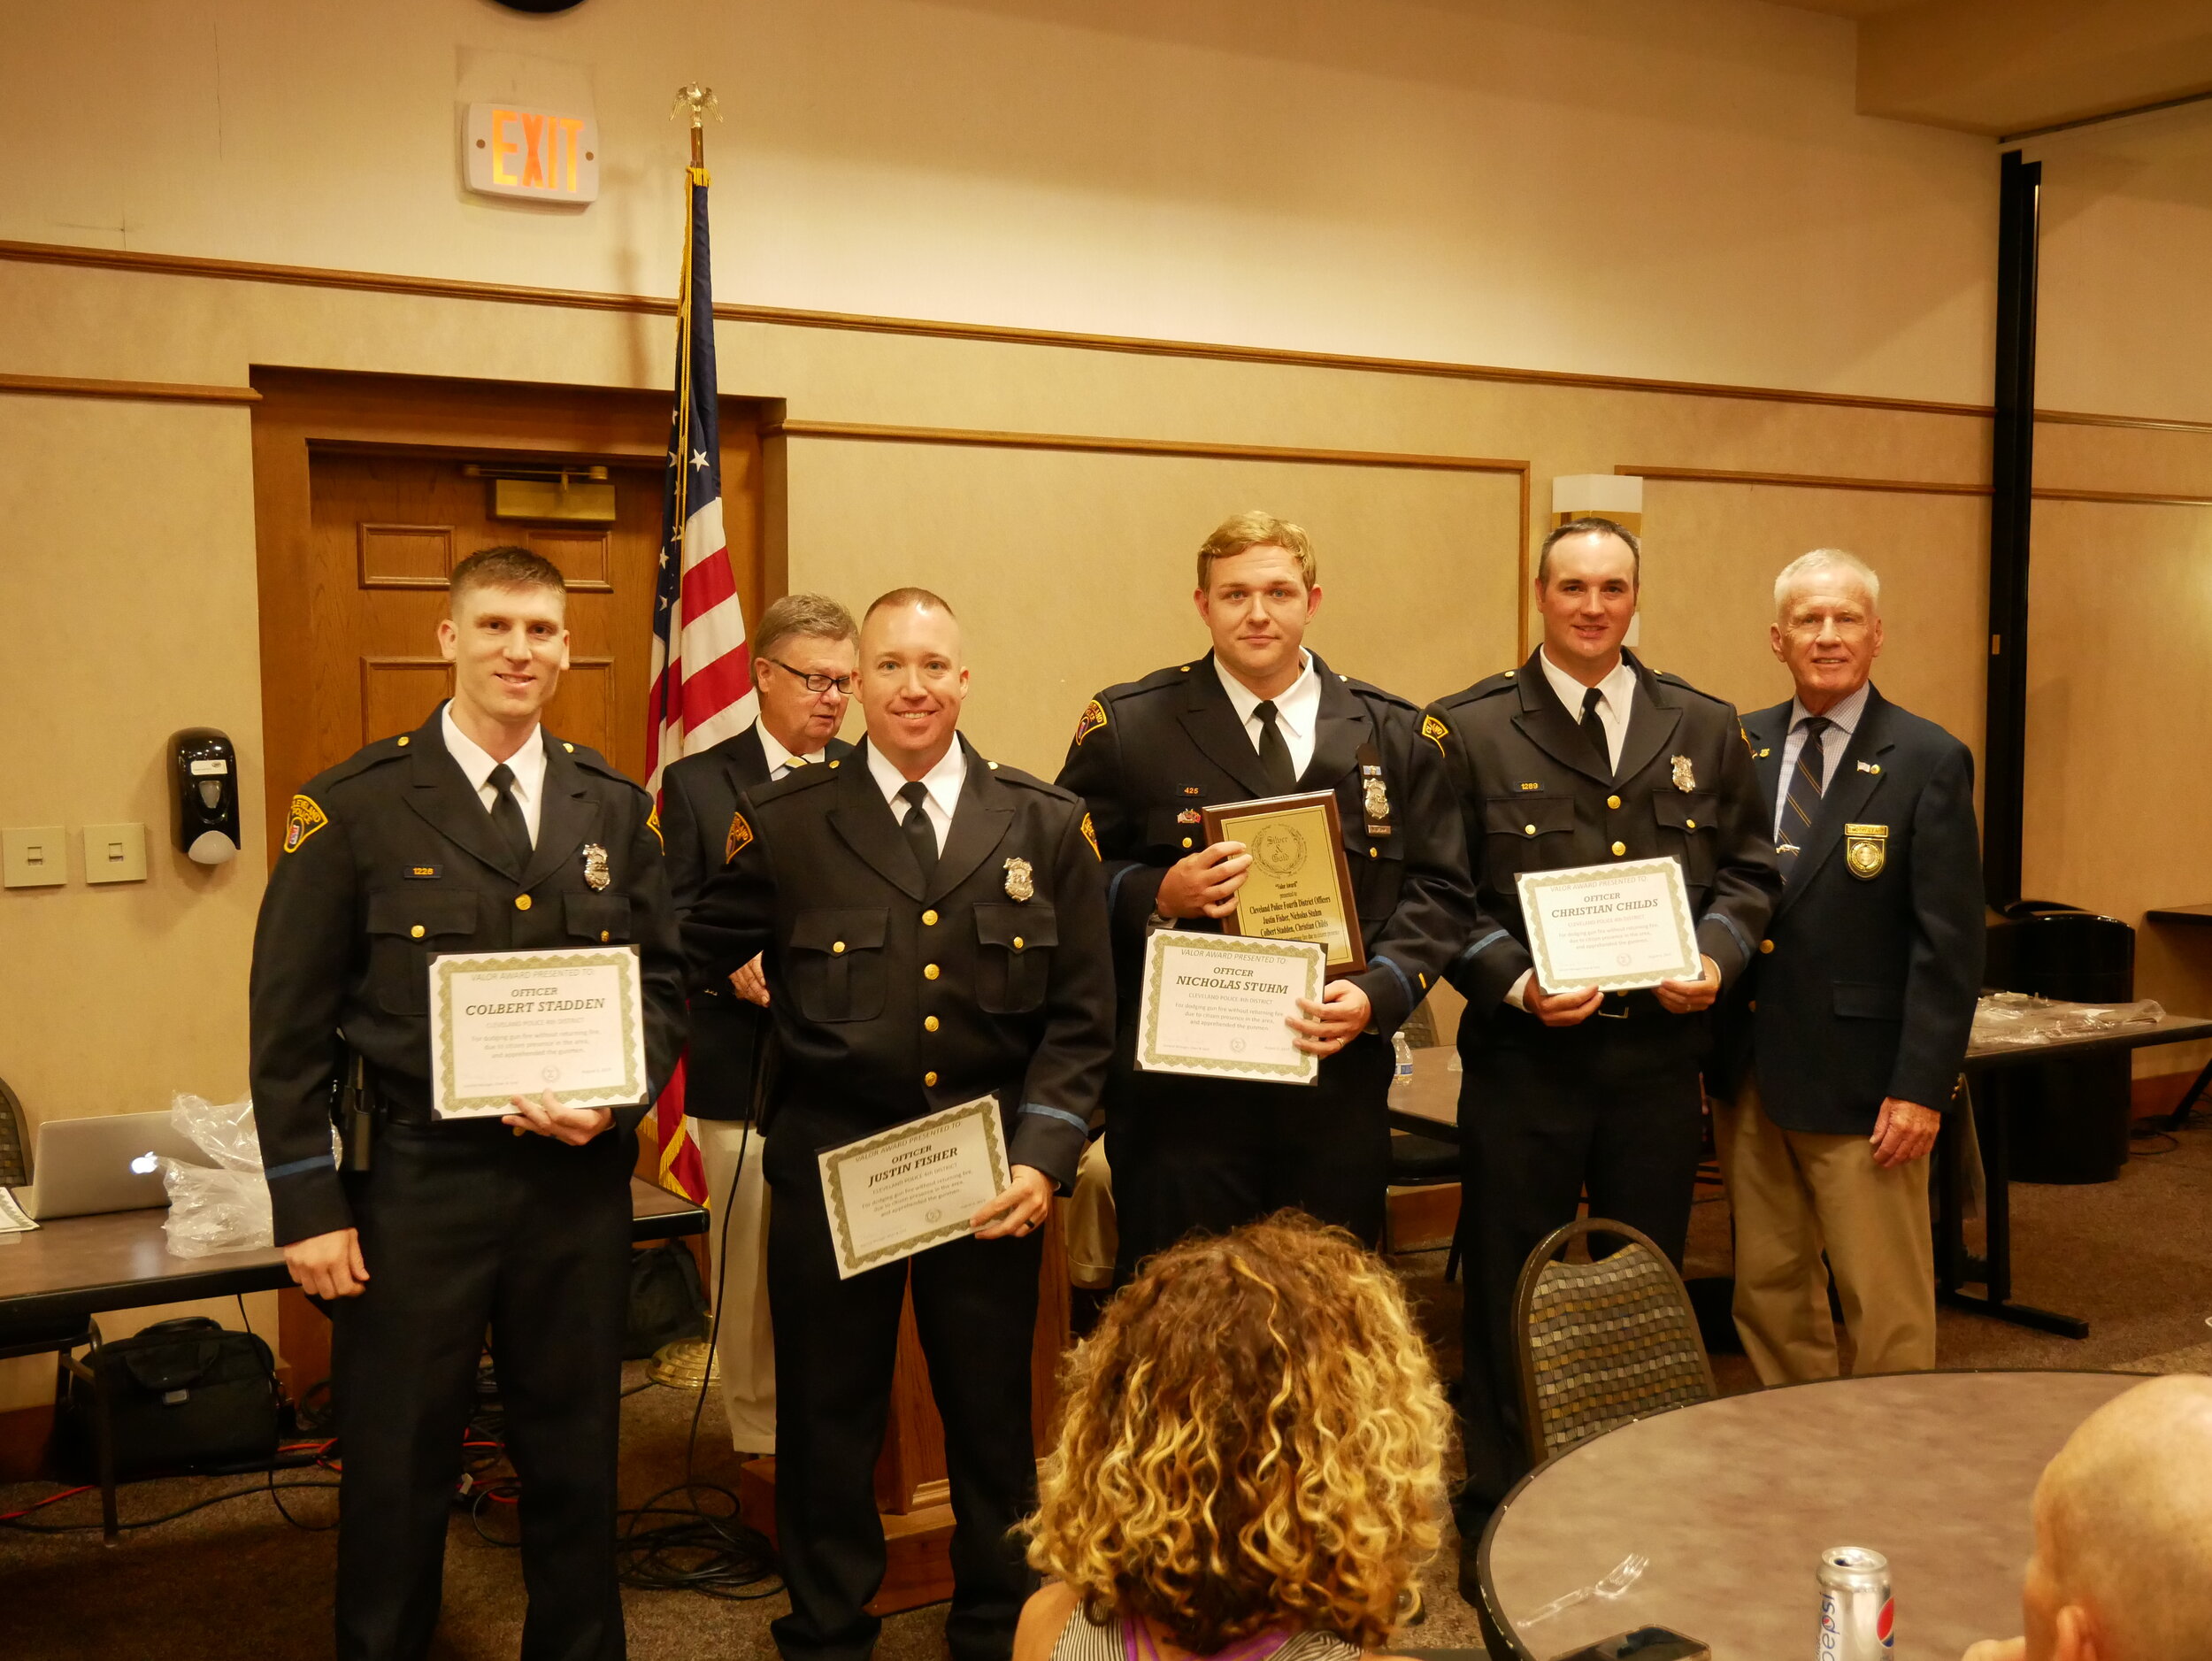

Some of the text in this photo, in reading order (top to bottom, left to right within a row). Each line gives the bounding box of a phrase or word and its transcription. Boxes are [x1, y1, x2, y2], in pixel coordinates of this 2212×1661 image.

[492, 110, 584, 192] EXIT
[1599, 877, 1635, 887] PRESENTED
[1249, 895, 1331, 914] Cleveland Police Fourth District Officers
[1584, 892, 1620, 902] OFFICER
[1263, 915, 1275, 924] Justin
[1290, 910, 1308, 919] Nicholas
[1309, 908, 1322, 917] Stuhm
[1551, 898, 1658, 918] CHRISTIAN CHILDS
[1260, 927, 1276, 936] Colbert
[1295, 921, 1314, 932] Christian
[1180, 948, 1203, 957] VALOR
[1205, 950, 1232, 959] AWARD
[1233, 953, 1274, 963] PRESENTED
[500, 971, 530, 980] AWARD
[533, 969, 580, 978] PRESENTED
[1213, 966, 1254, 977] OFFICER
[511, 987, 557, 997] OFFICER
[1175, 975, 1288, 994] NICHOLAS STUHM
[465, 997, 604, 1016] COLBERT STADDEN
[856, 1150, 878, 1163] VALOR
[880, 1139, 907, 1154] AWARD
[909, 1124, 949, 1143] PRESENTED
[891, 1144, 932, 1164] OFFICER
[867, 1146, 957, 1188] JUSTIN FISHER
